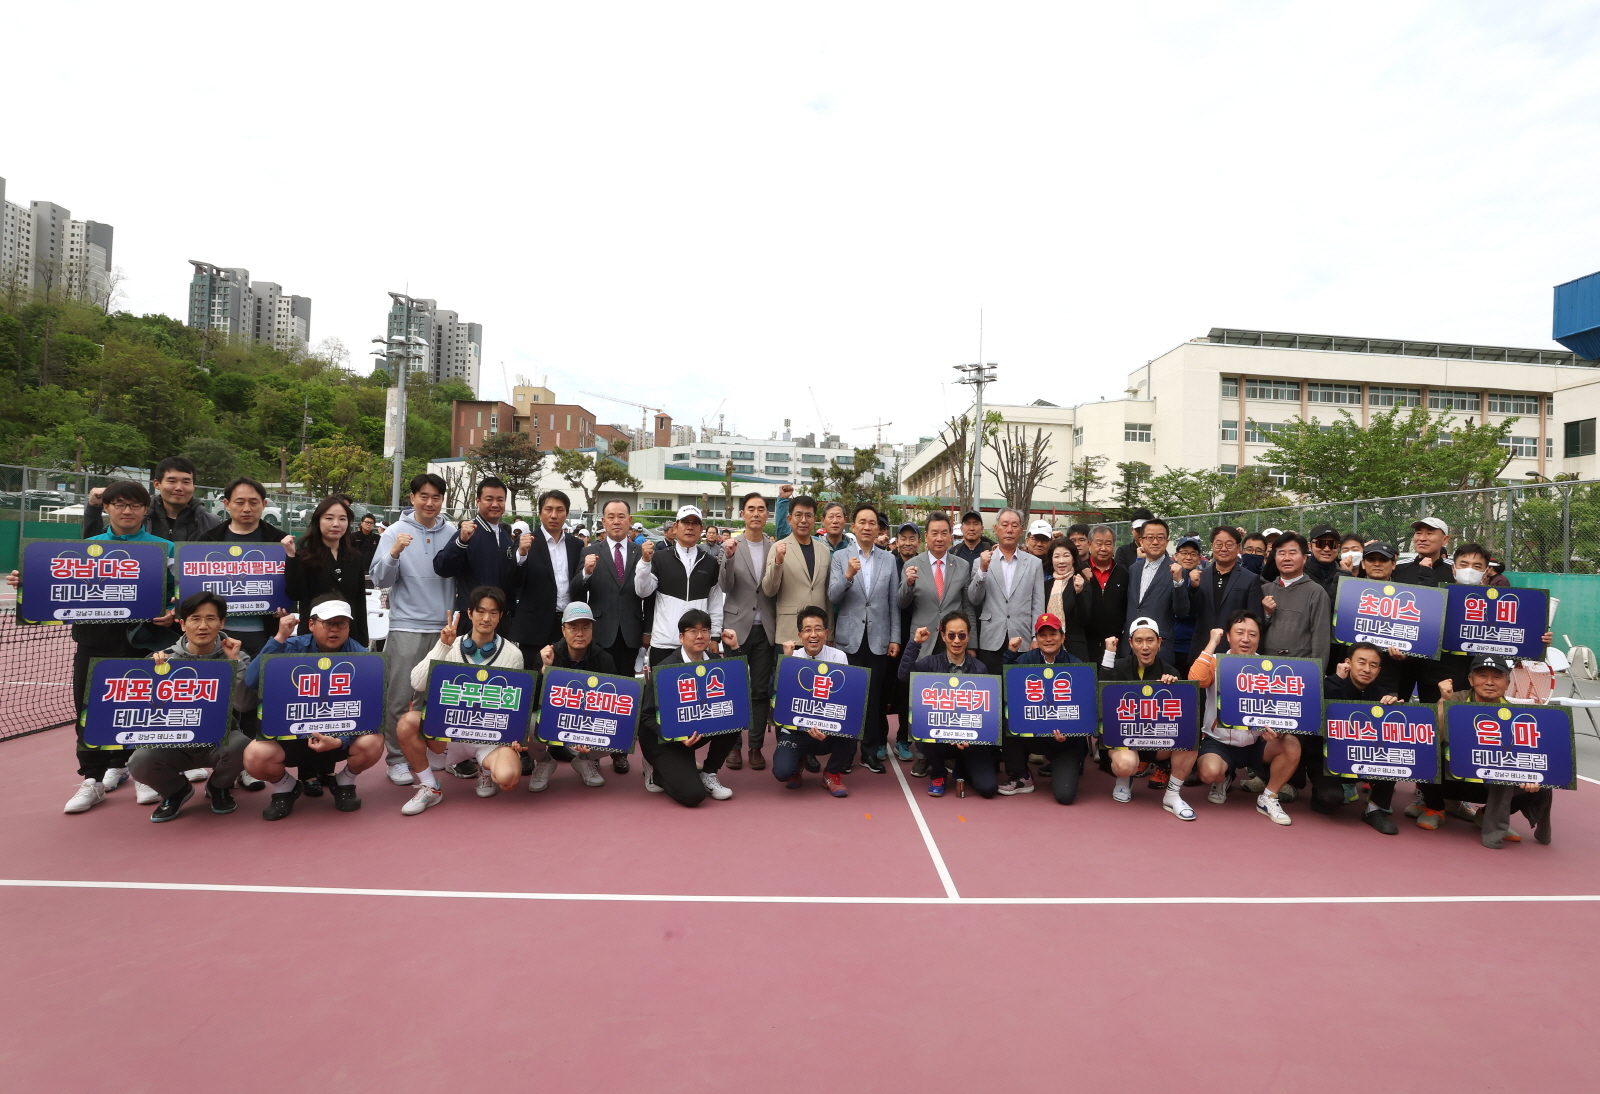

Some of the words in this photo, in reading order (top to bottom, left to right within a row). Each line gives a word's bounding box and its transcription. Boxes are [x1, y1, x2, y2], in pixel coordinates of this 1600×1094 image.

[50, 558, 96, 579] 강남
[97, 559, 141, 579] 다온
[51, 584, 138, 602] 테니스클럽
[202, 580, 274, 597] 테니스클럽
[75, 610, 93, 618] 강남구
[1357, 594, 1421, 622] 초이스
[1354, 617, 1420, 641] 테니스클럽
[1459, 624, 1525, 643] 테니스클럽
[1476, 644, 1489, 652] 강남구
[1489, 645, 1503, 653] 테니스
[102, 678, 153, 703] 개포
[156, 678, 220, 702] 6단지
[812, 674, 833, 700] 탑
[1236, 672, 1304, 697] 아후스타
[439, 680, 522, 711] 늘푸른회
[549, 685, 585, 709] 강남
[585, 690, 634, 716] 한마음
[921, 687, 990, 712] 역삼럭키
[113, 708, 202, 727] 테니스클럽
[286, 700, 361, 720] 테니스클럽
[677, 700, 734, 723] 테니스클럽
[791, 697, 847, 721] 테니스클럽
[1024, 705, 1080, 721] 테니스클럽
[1116, 698, 1183, 721] 산마루
[1238, 698, 1301, 718] 테니스클럽
[308, 723, 324, 731] 강남구
[324, 722, 340, 730] 테니스
[341, 721, 351, 729] 협회
[444, 708, 510, 730] 테니스클럽
[557, 713, 618, 735] 테니스클럽
[927, 711, 983, 729] 테니스클럽
[137, 733, 156, 741] 강남구
[176, 732, 188, 740] 협회
[1120, 722, 1179, 738] 테니스클럽
[1327, 719, 1378, 742] 테니스
[1382, 721, 1435, 745] 매니아
[1347, 746, 1416, 766] 테니스클럽
[1471, 749, 1548, 771] 테니스클럽
[1494, 770, 1510, 778] 강남구
[1510, 772, 1527, 780] 테니스
[1527, 773, 1538, 781] 협회
